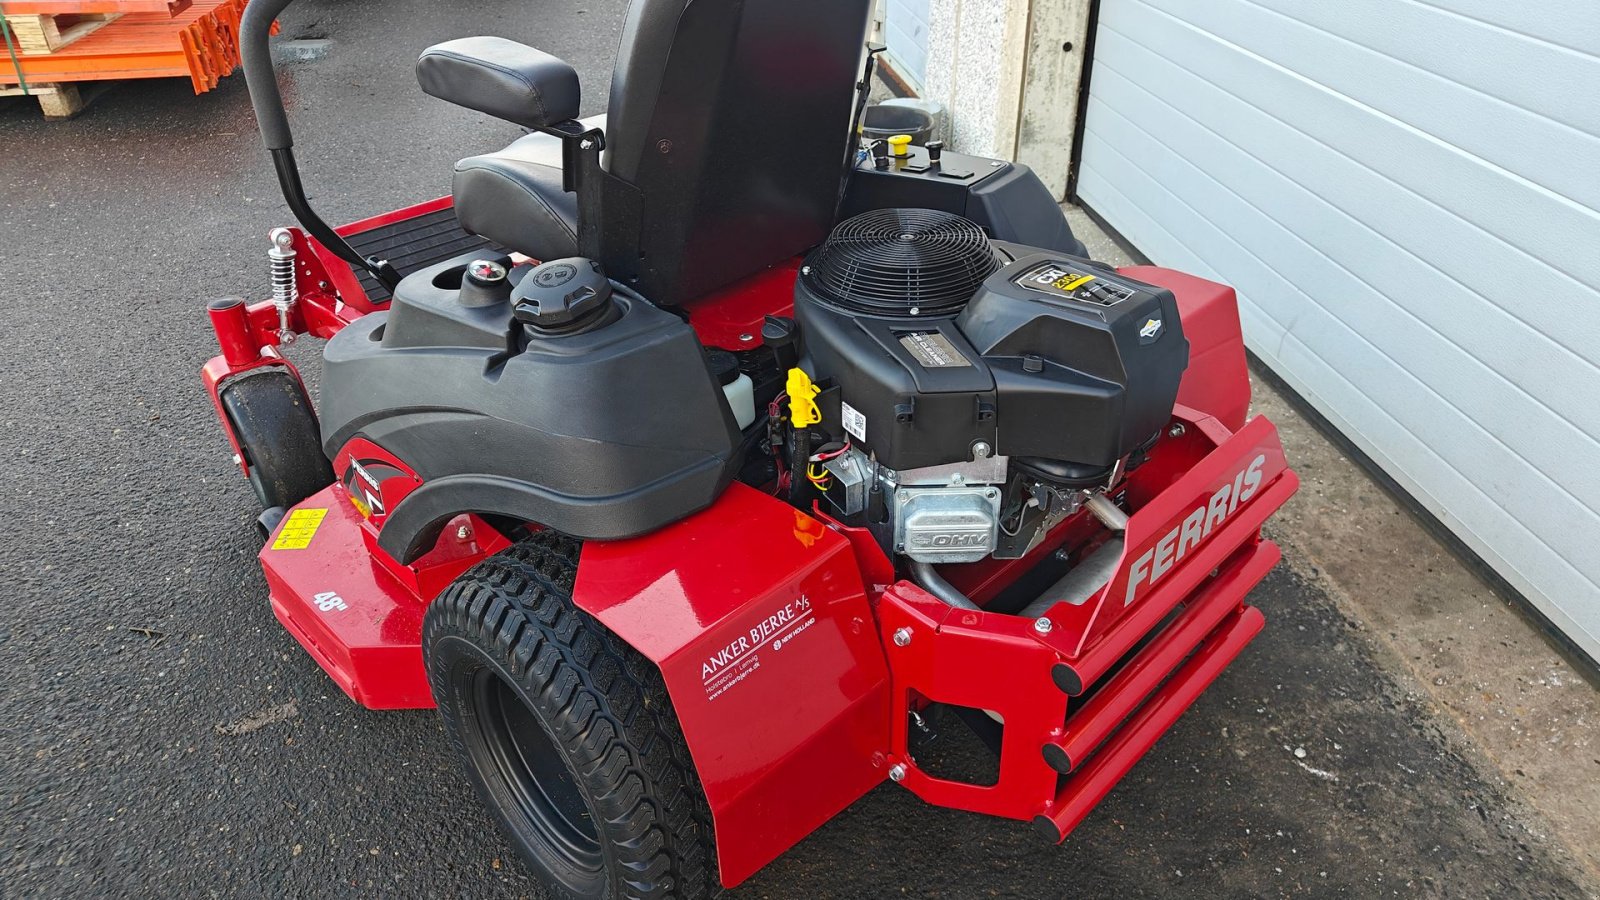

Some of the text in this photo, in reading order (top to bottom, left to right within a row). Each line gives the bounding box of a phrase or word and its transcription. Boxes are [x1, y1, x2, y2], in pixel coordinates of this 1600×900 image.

[1052, 273, 1081, 289] 2300
[919, 341, 945, 365] CLEANER
[930, 533, 989, 547] OHV
[1124, 454, 1265, 608] FERRIS
[702, 594, 810, 680] ANKER BJERRE A/S
[781, 617, 816, 644] NEW HOLLAND
[705, 654, 759, 694] Holstebro Lemvig
[708, 663, 760, 701] www.ankerbjerre.dk
